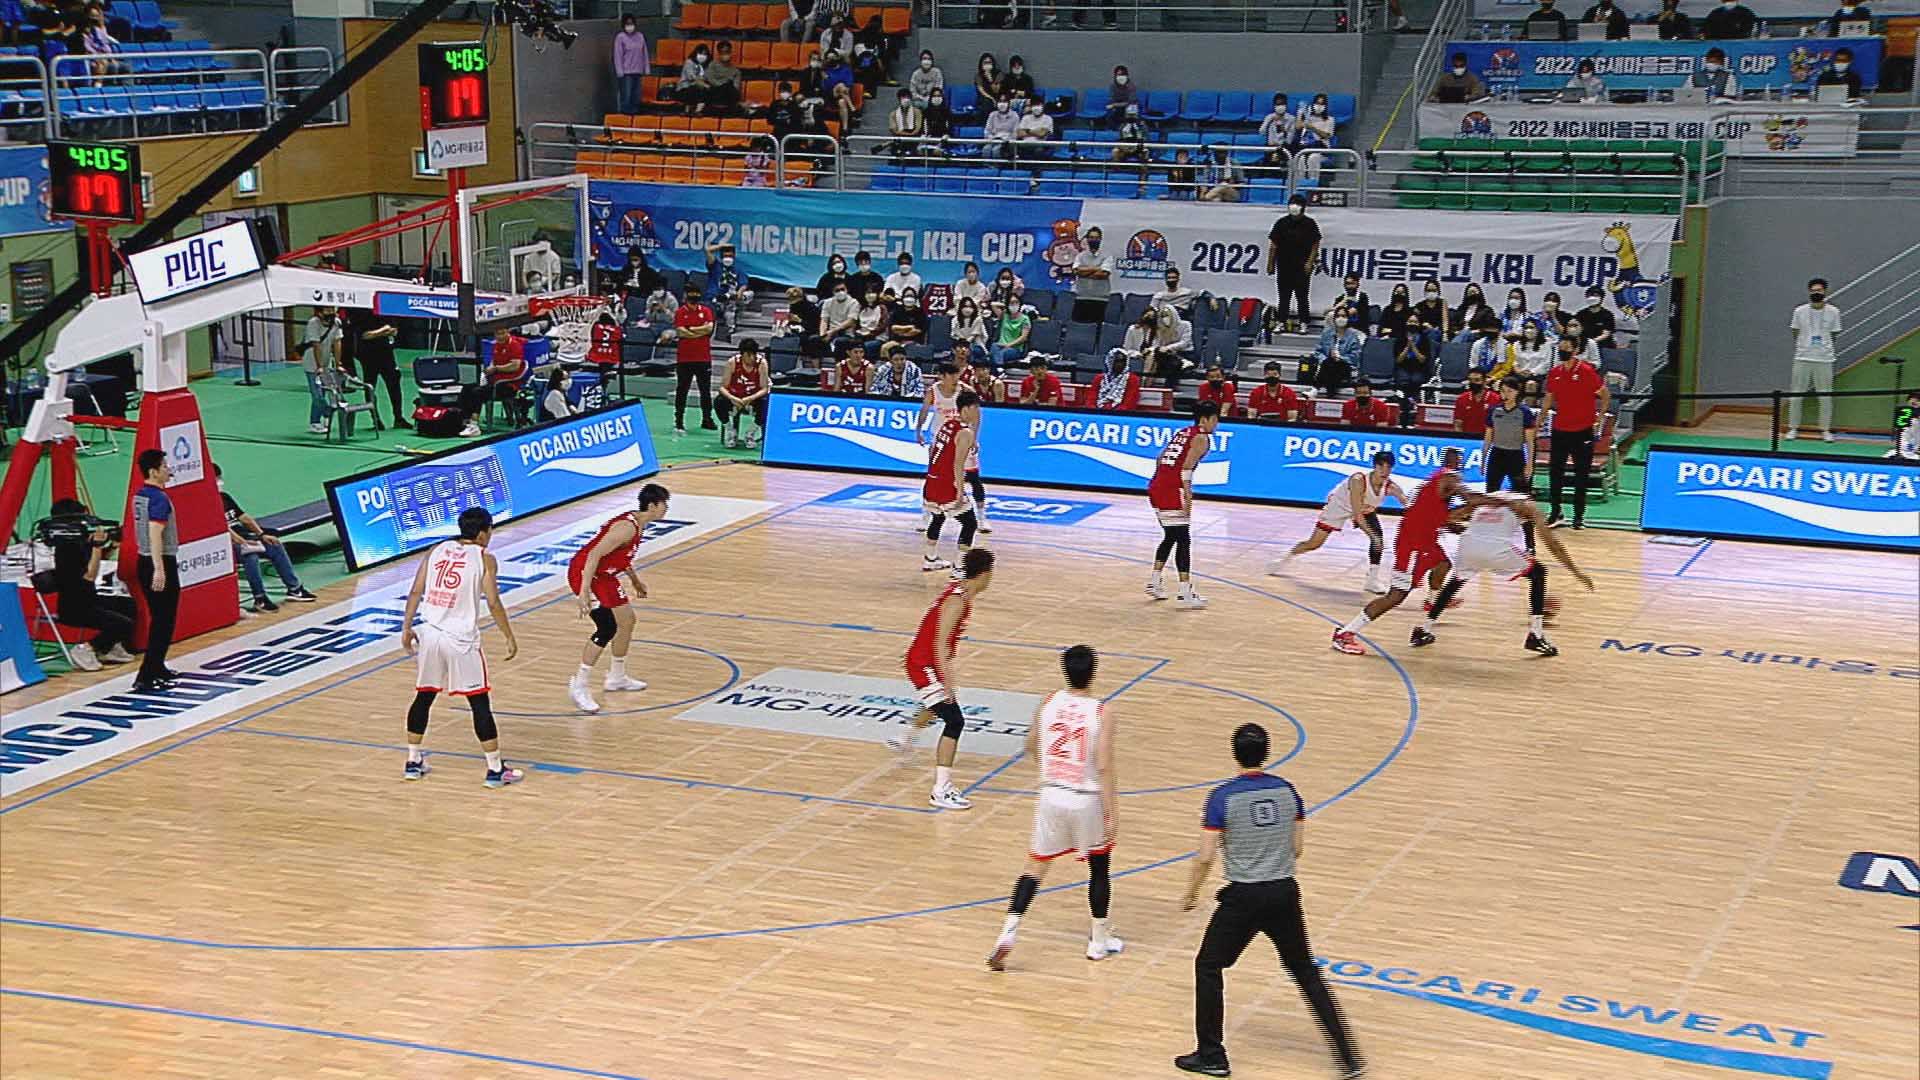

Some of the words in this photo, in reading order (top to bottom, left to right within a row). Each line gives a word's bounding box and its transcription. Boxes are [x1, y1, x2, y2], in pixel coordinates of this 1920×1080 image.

[445, 48, 485, 71] 4:05
[1535, 56, 1576, 74] 2022
[1580, 56, 1694, 75] G새마을금고
[1740, 55, 1778, 73] CUP
[450, 76, 481, 117] 17
[1507, 120, 1550, 139] 2022
[1553, 121, 1669, 139] MG새마을금고
[1676, 122, 1705, 140] KBL
[1715, 122, 1751, 139] CUP
[69, 147, 128, 171] 4:05
[76, 173, 120, 213] 17
[674, 220, 735, 250] 2022
[741, 223, 915, 261] MG새마을금고
[922, 230, 974, 262] KBL
[981, 232, 1034, 263] CUP
[1190, 242, 1261, 274] 2022
[1314, 247, 1473, 283] 새마을금고
[1482, 253, 1543, 285] KBL
[1554, 255, 1619, 287] CUP
[438, 300, 458, 309] SWE
[929, 296, 947, 311] 23
[791, 402, 885, 428] POCARI
[519, 428, 580, 466] POCARI
[583, 414, 633, 448] SWEAT
[1029, 418, 1129, 445] POCARI
[1135, 425, 1234, 452] SWT
[394, 458, 502, 510] POCARI
[1678, 461, 1803, 490] POCARI
[1811, 470, 1919, 499] SWEA
[177, 549, 227, 573] G새마을금고
[434, 560, 467, 589] 15
[1047, 722, 1088, 761] 21
[1558, 994, 1828, 1050] SWEAT
